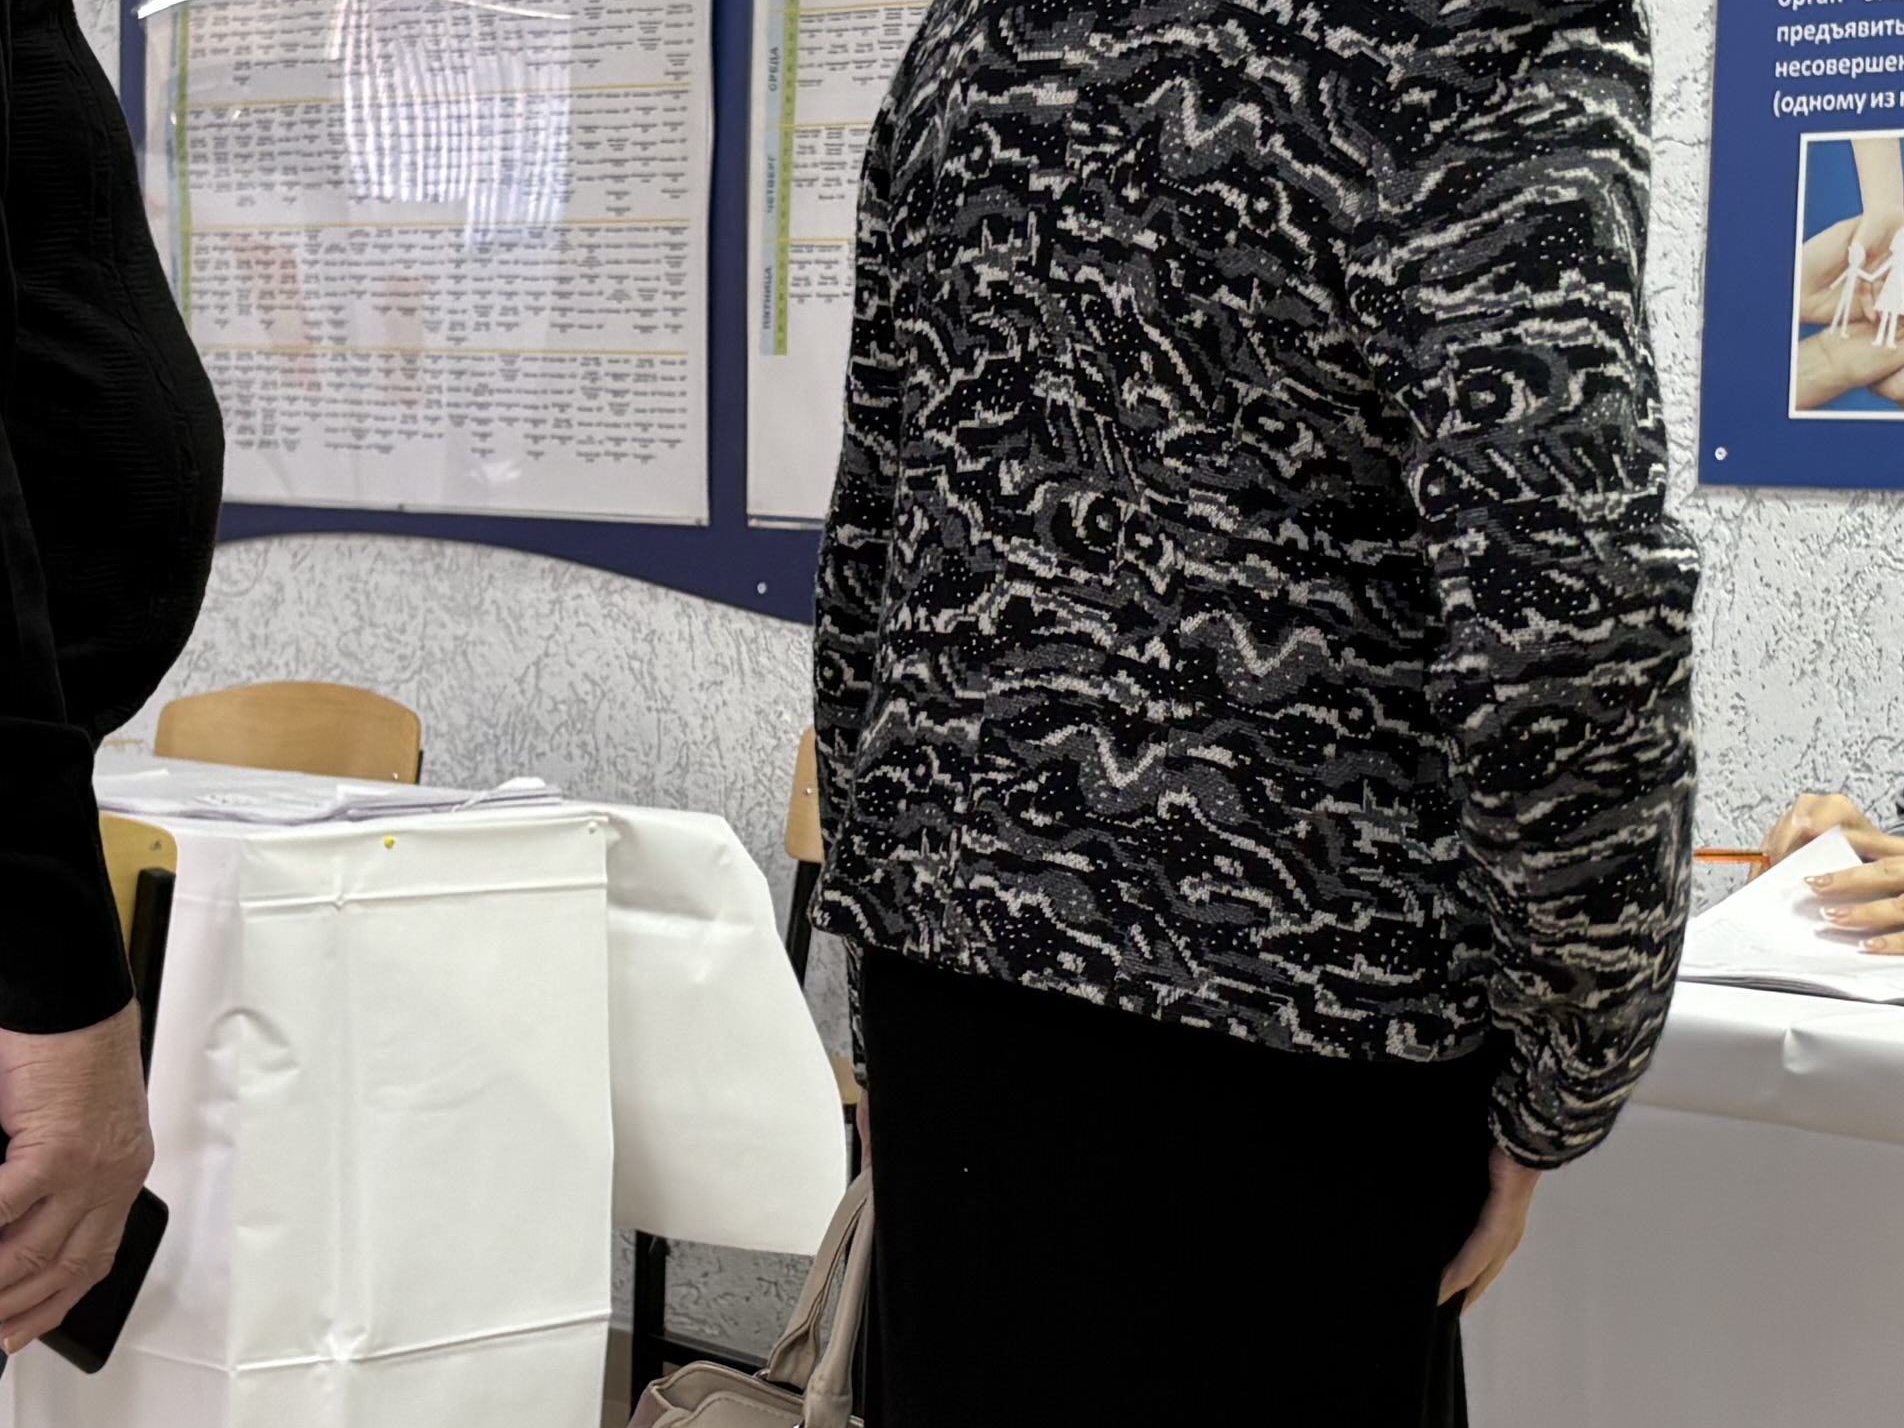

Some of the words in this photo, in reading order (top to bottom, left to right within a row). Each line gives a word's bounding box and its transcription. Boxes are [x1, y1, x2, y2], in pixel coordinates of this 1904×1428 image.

[768, 47, 779, 93] СРЕДА
[1773, 91, 1867, 118] (одному
[1870, 91, 1895, 109] из
[766, 154, 777, 214] ЧЕТВЕРГ
